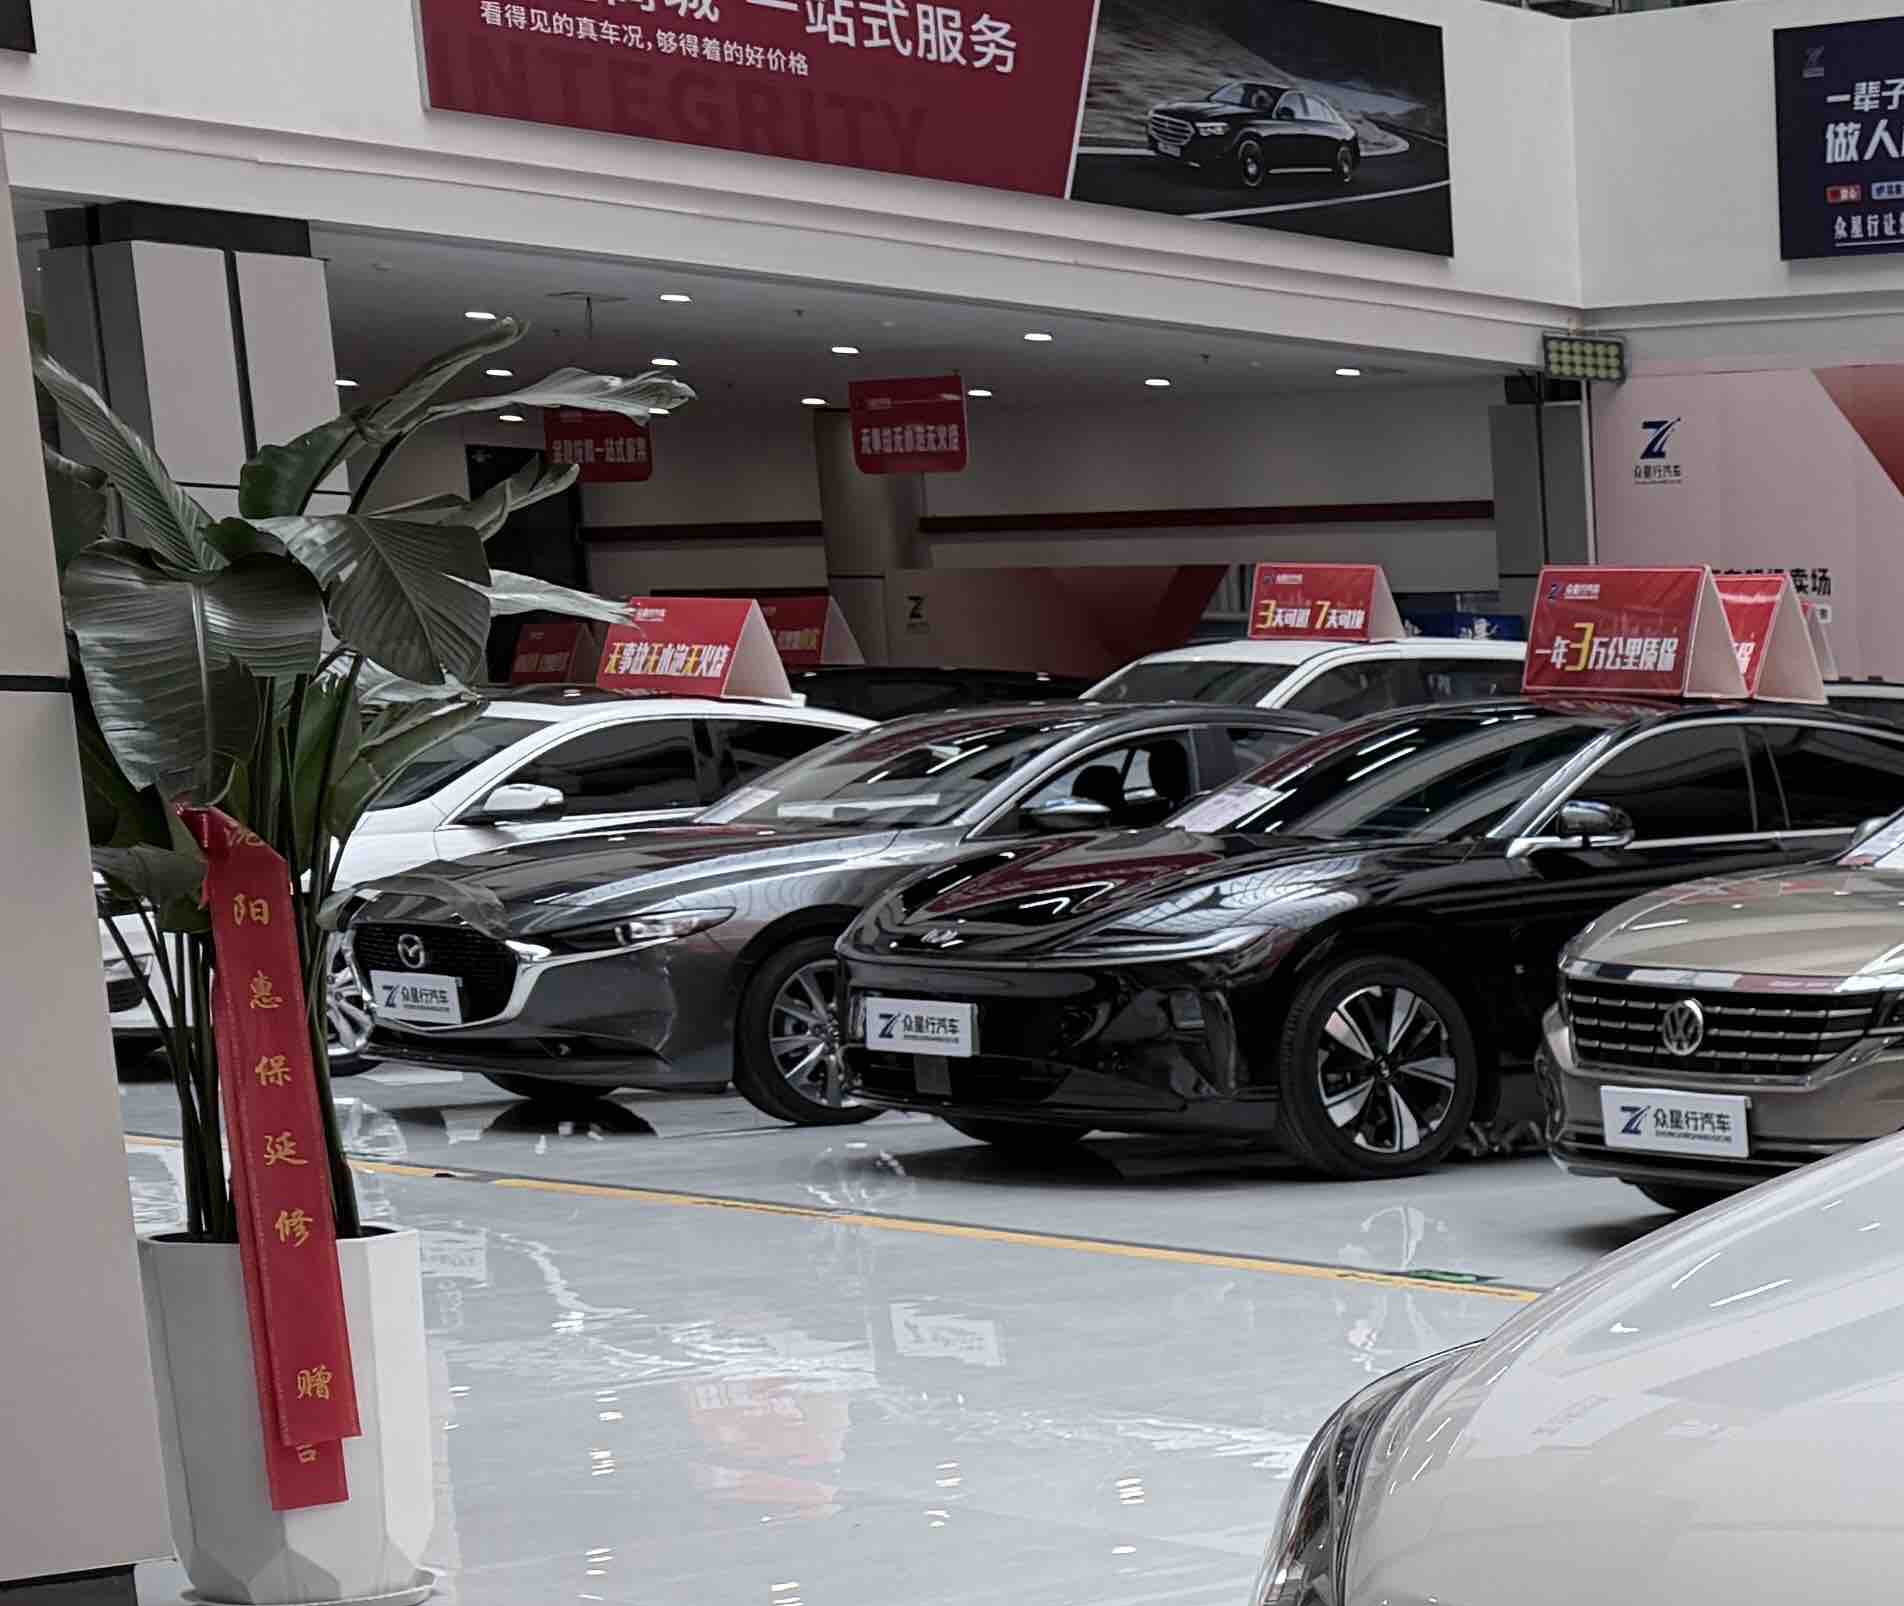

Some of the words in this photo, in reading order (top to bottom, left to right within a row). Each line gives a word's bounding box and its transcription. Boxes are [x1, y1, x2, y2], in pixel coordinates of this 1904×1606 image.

[1535, 621, 1680, 673] 一年3万公里质保
[903, 1014, 960, 1034] 众星行汽车
[1653, 1108, 1732, 1134] 众星行汽车
